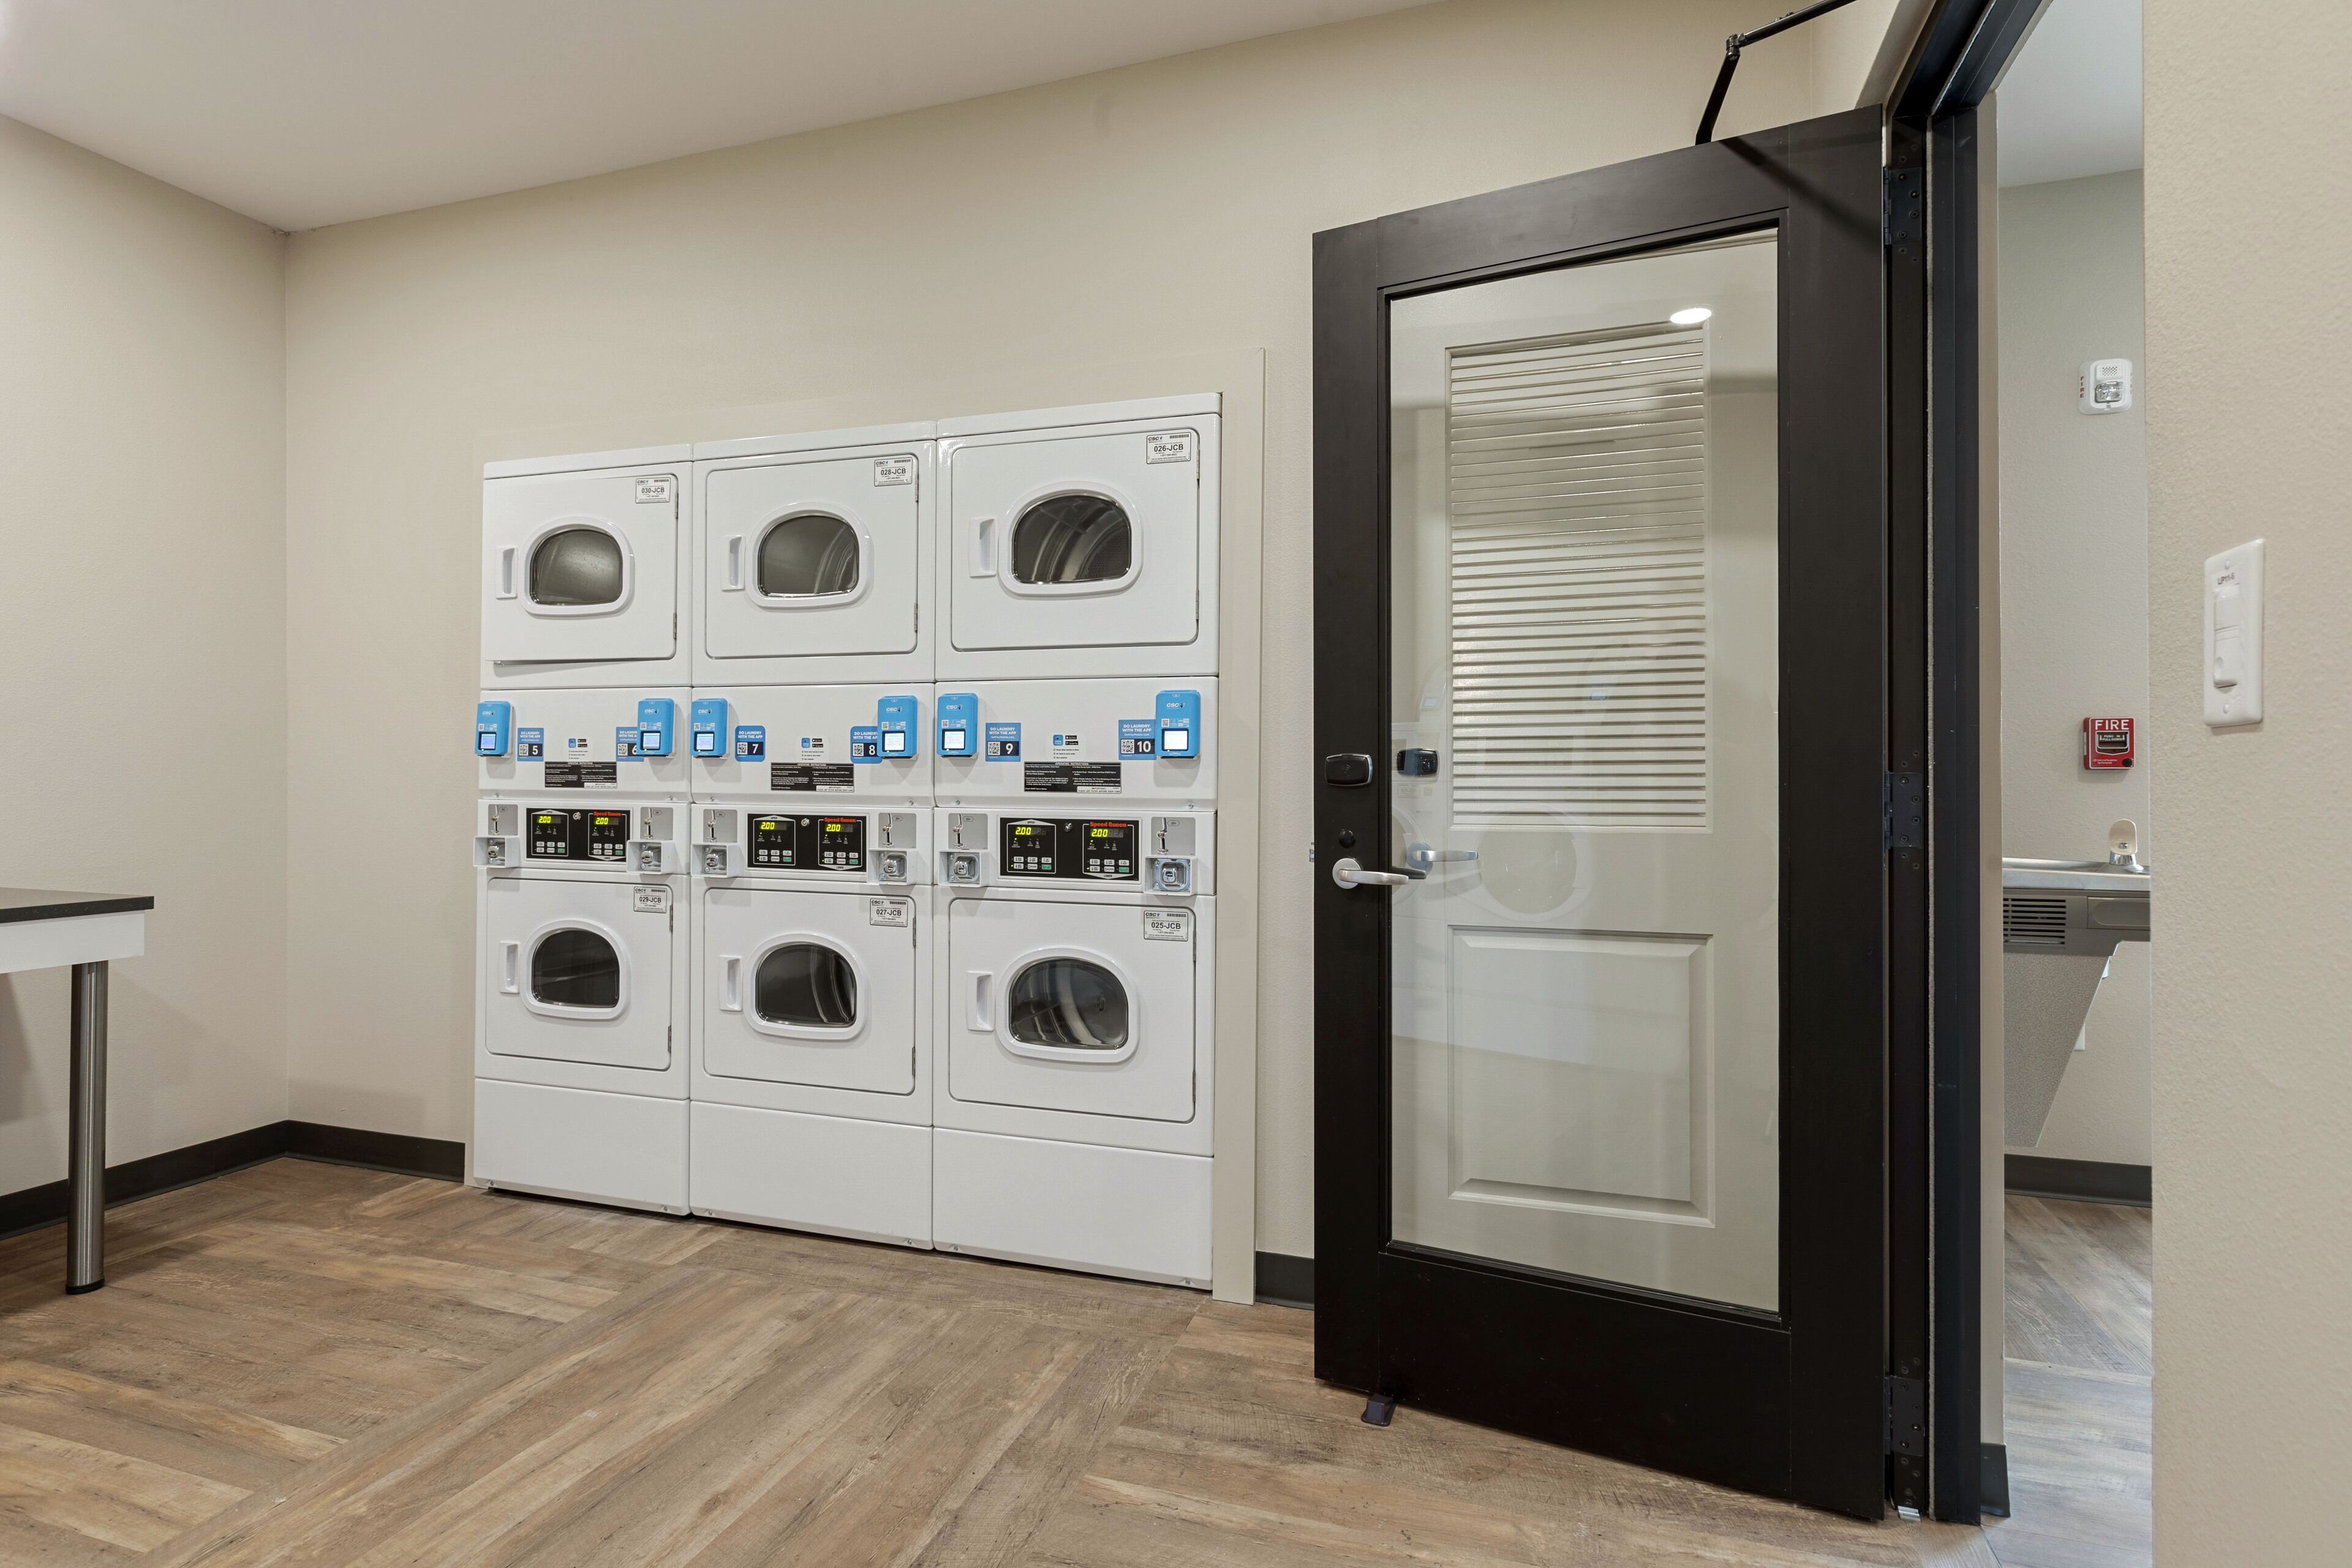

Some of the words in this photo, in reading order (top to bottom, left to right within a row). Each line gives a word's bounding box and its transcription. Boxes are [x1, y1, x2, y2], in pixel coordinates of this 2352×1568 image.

[2095, 719, 2130, 730] FIRE
[532, 745, 538, 755] 5
[632, 745, 637, 755] 6
[752, 744, 759, 754] 7
[869, 745, 876, 755] 8
[1005, 743, 1013, 754] 9
[1137, 741, 1152, 753] 10
[1016, 827, 1031, 835] 2.00
[1091, 829, 1108, 837] 2.00
